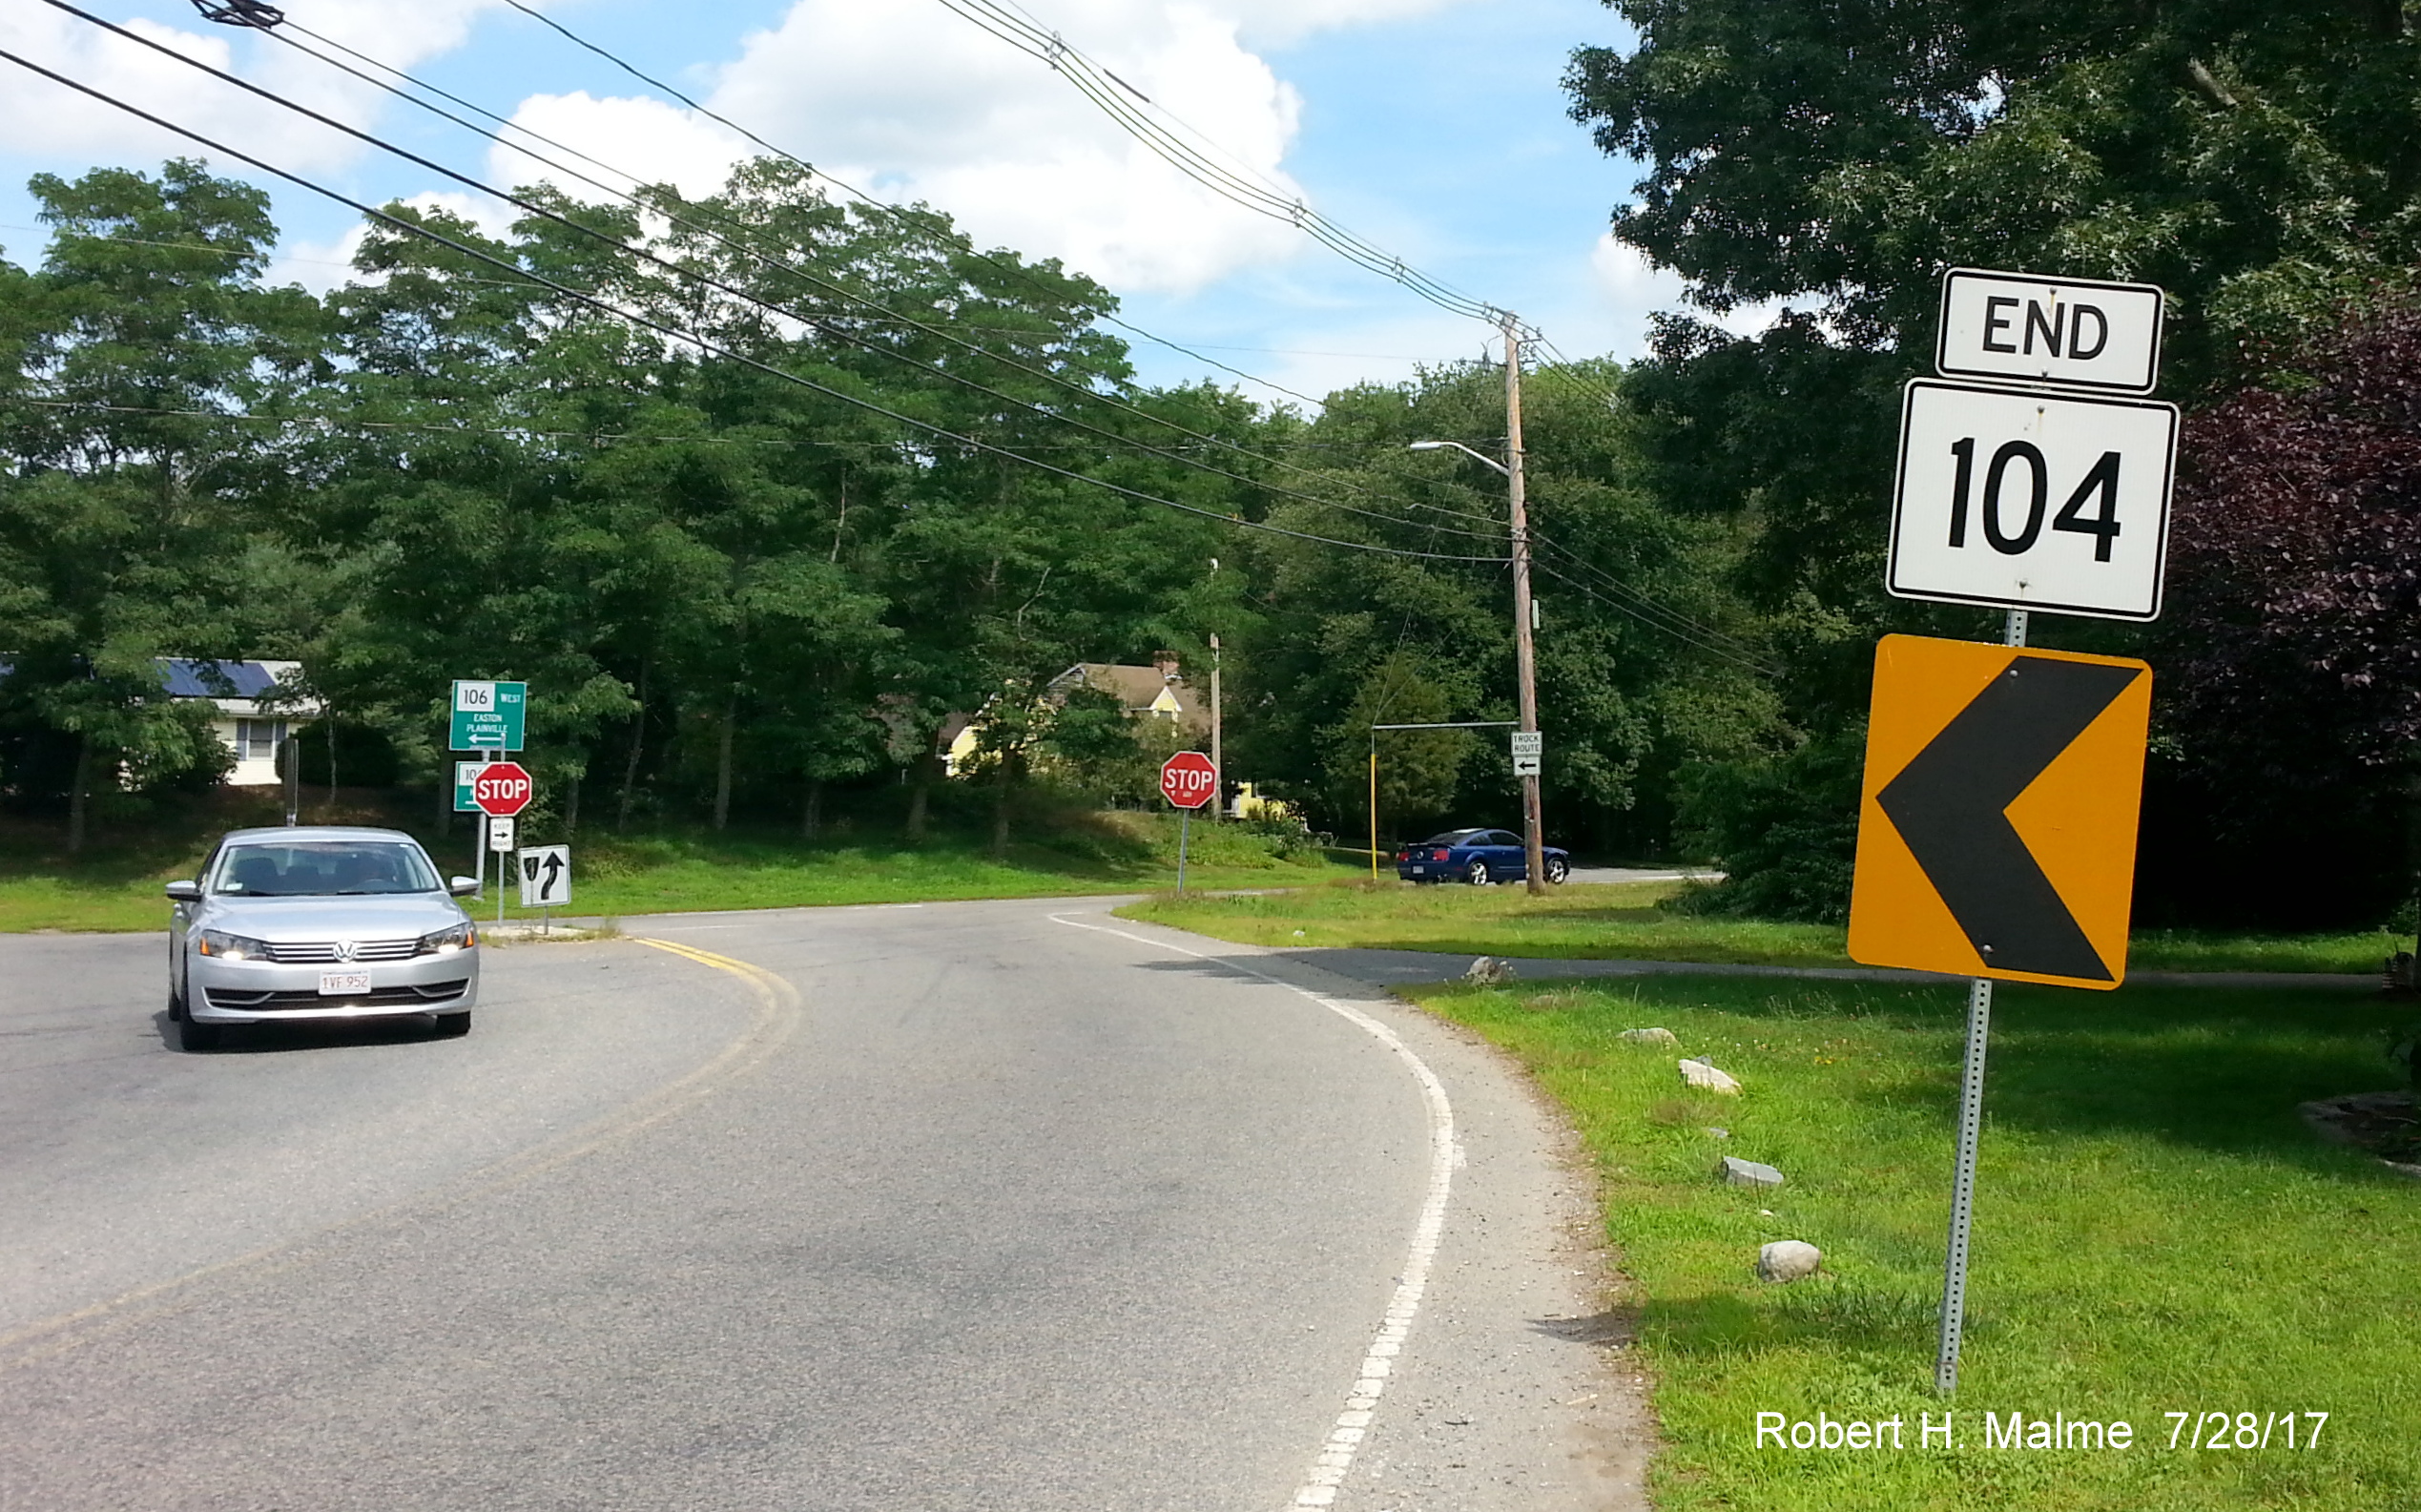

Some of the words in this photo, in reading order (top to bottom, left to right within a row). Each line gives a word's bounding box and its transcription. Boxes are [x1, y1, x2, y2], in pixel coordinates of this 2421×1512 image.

[1982, 296, 2108, 361] END
[1948, 437, 2121, 563] 104
[464, 689, 487, 704] 106
[500, 694, 521, 703] WEST
[466, 724, 507, 733] PLAINVILLE
[473, 714, 502, 722] EASTON
[478, 778, 528, 799] STOP
[1165, 768, 1212, 791] STOP
